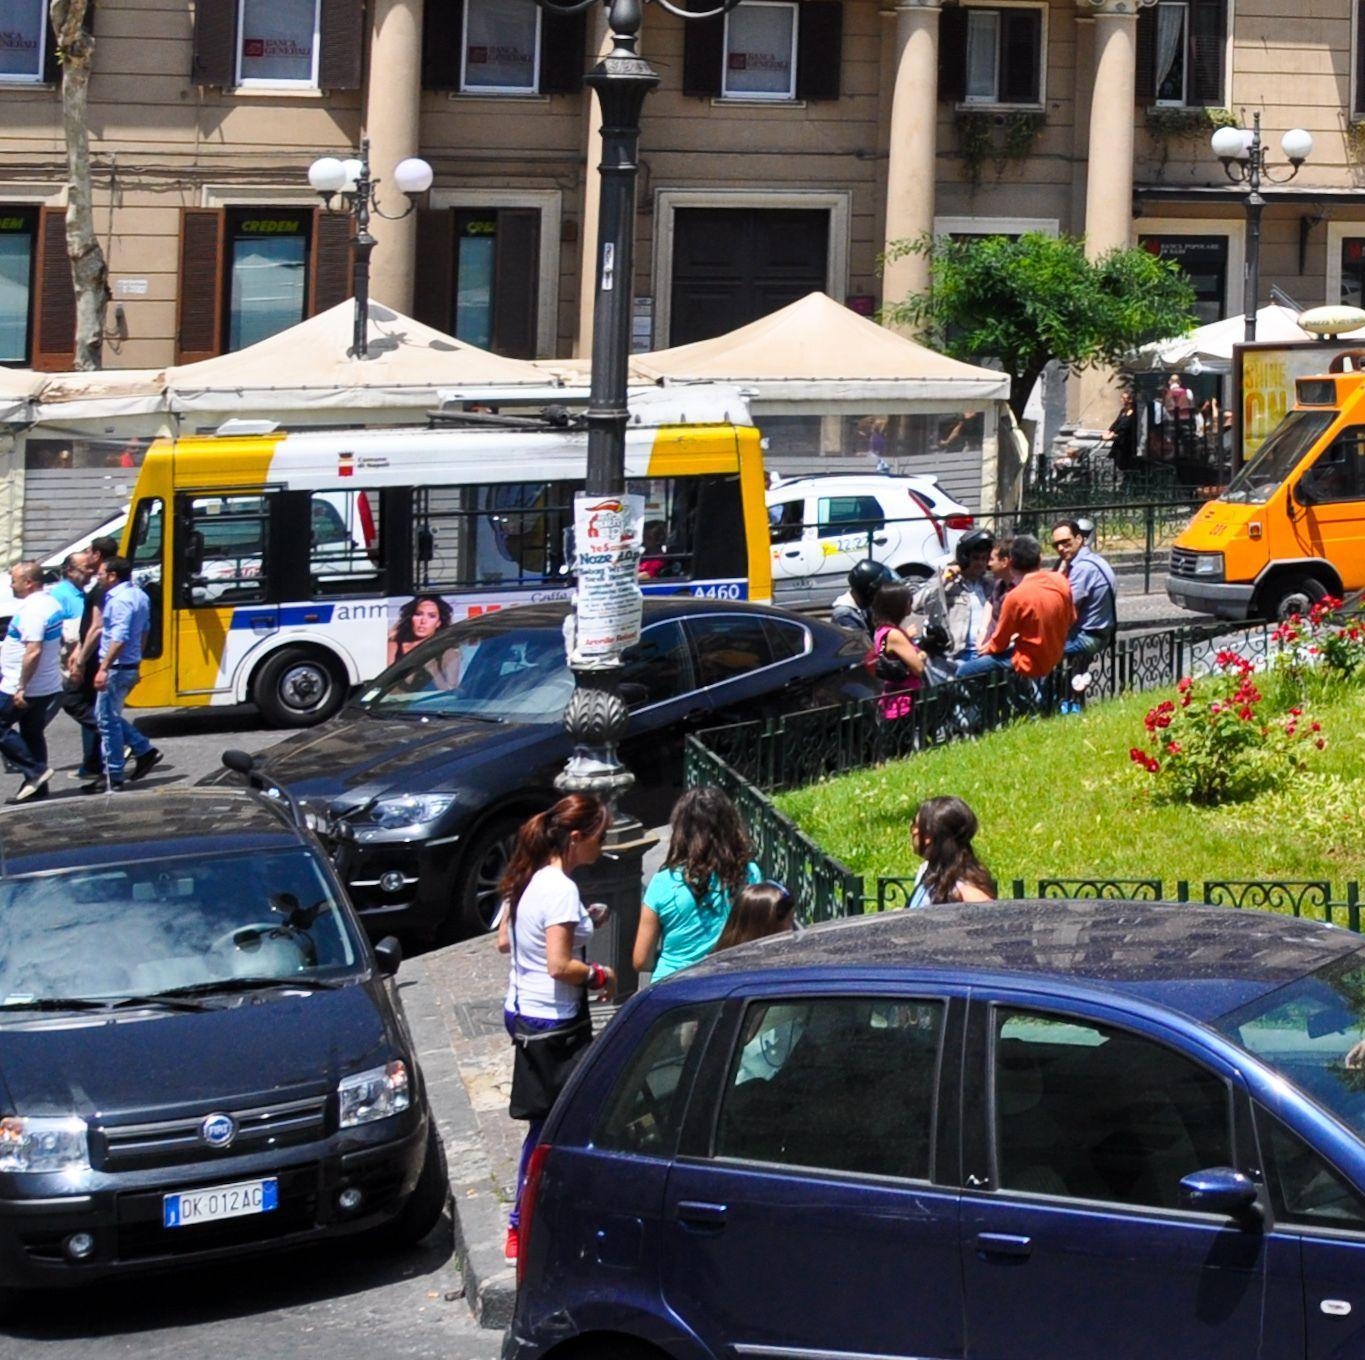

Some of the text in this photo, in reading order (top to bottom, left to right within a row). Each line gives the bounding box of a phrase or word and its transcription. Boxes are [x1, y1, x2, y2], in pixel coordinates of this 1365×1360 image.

[241, 219, 300, 233] CREDEM
[337, 603, 388, 620] anm
[181, 1197, 203, 1220] DK
